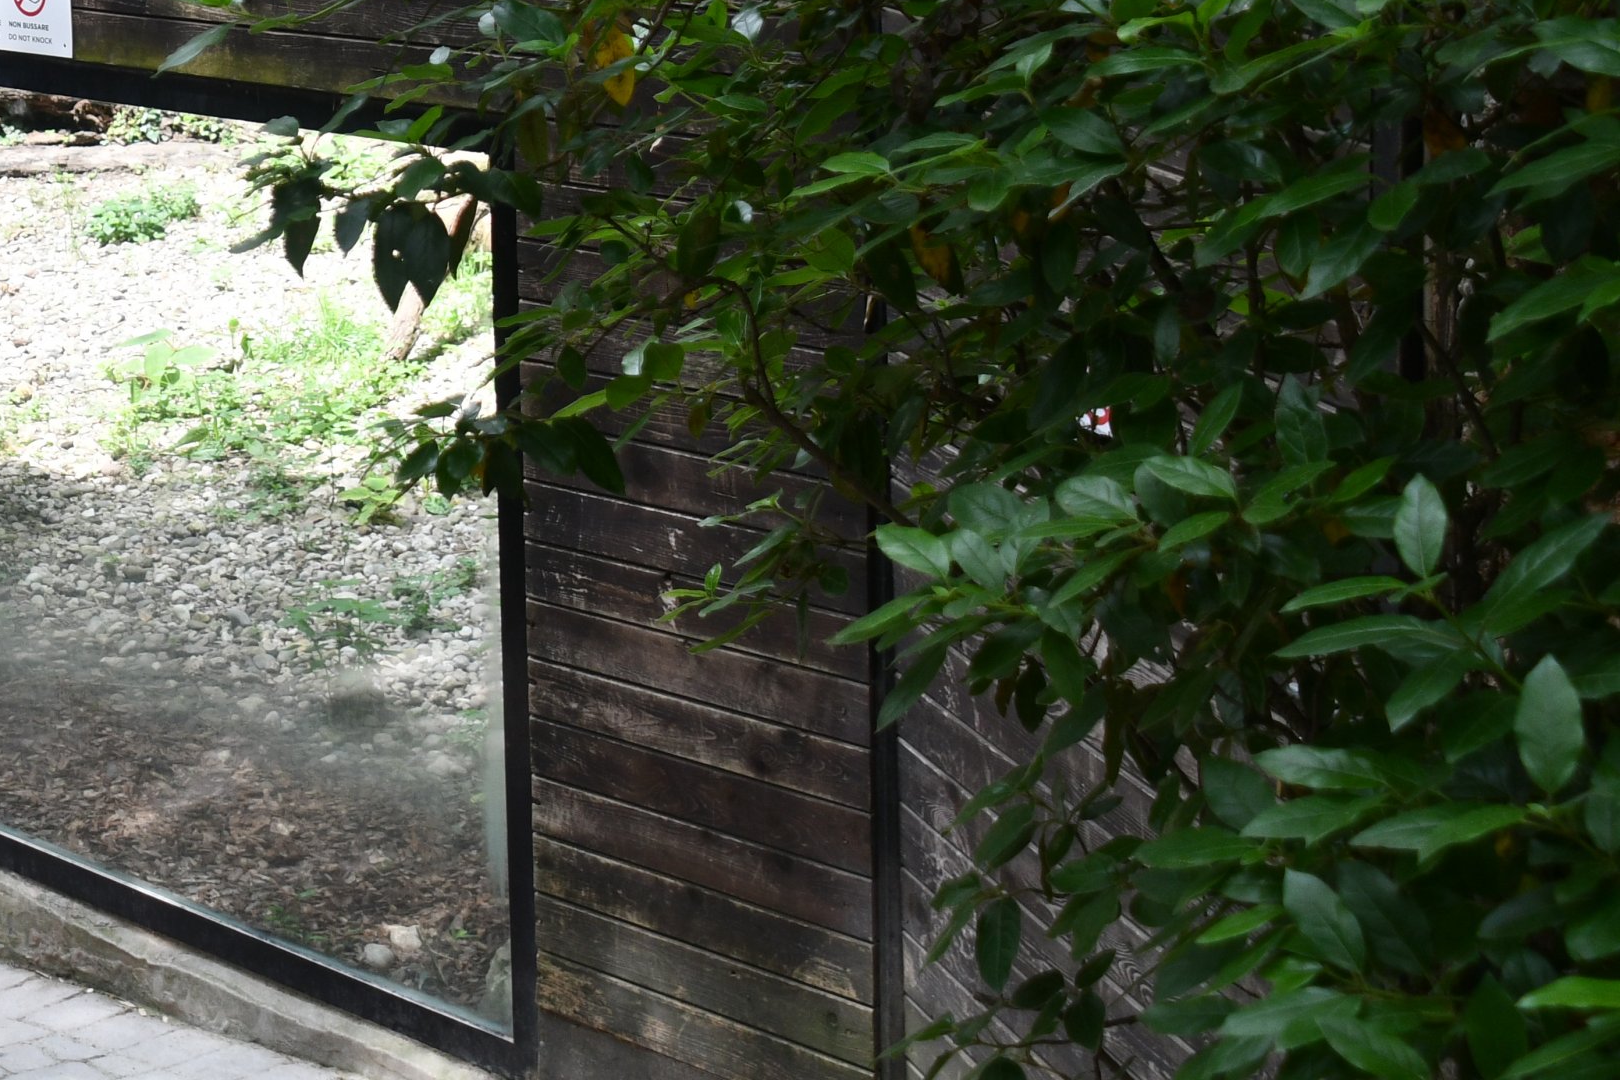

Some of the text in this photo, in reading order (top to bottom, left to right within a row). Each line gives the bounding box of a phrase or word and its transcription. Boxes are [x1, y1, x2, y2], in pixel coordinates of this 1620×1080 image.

[23, 22, 49, 31] BUSSARE
[8, 33, 17, 41] DO
[32, 36, 52, 45] KNOCK
